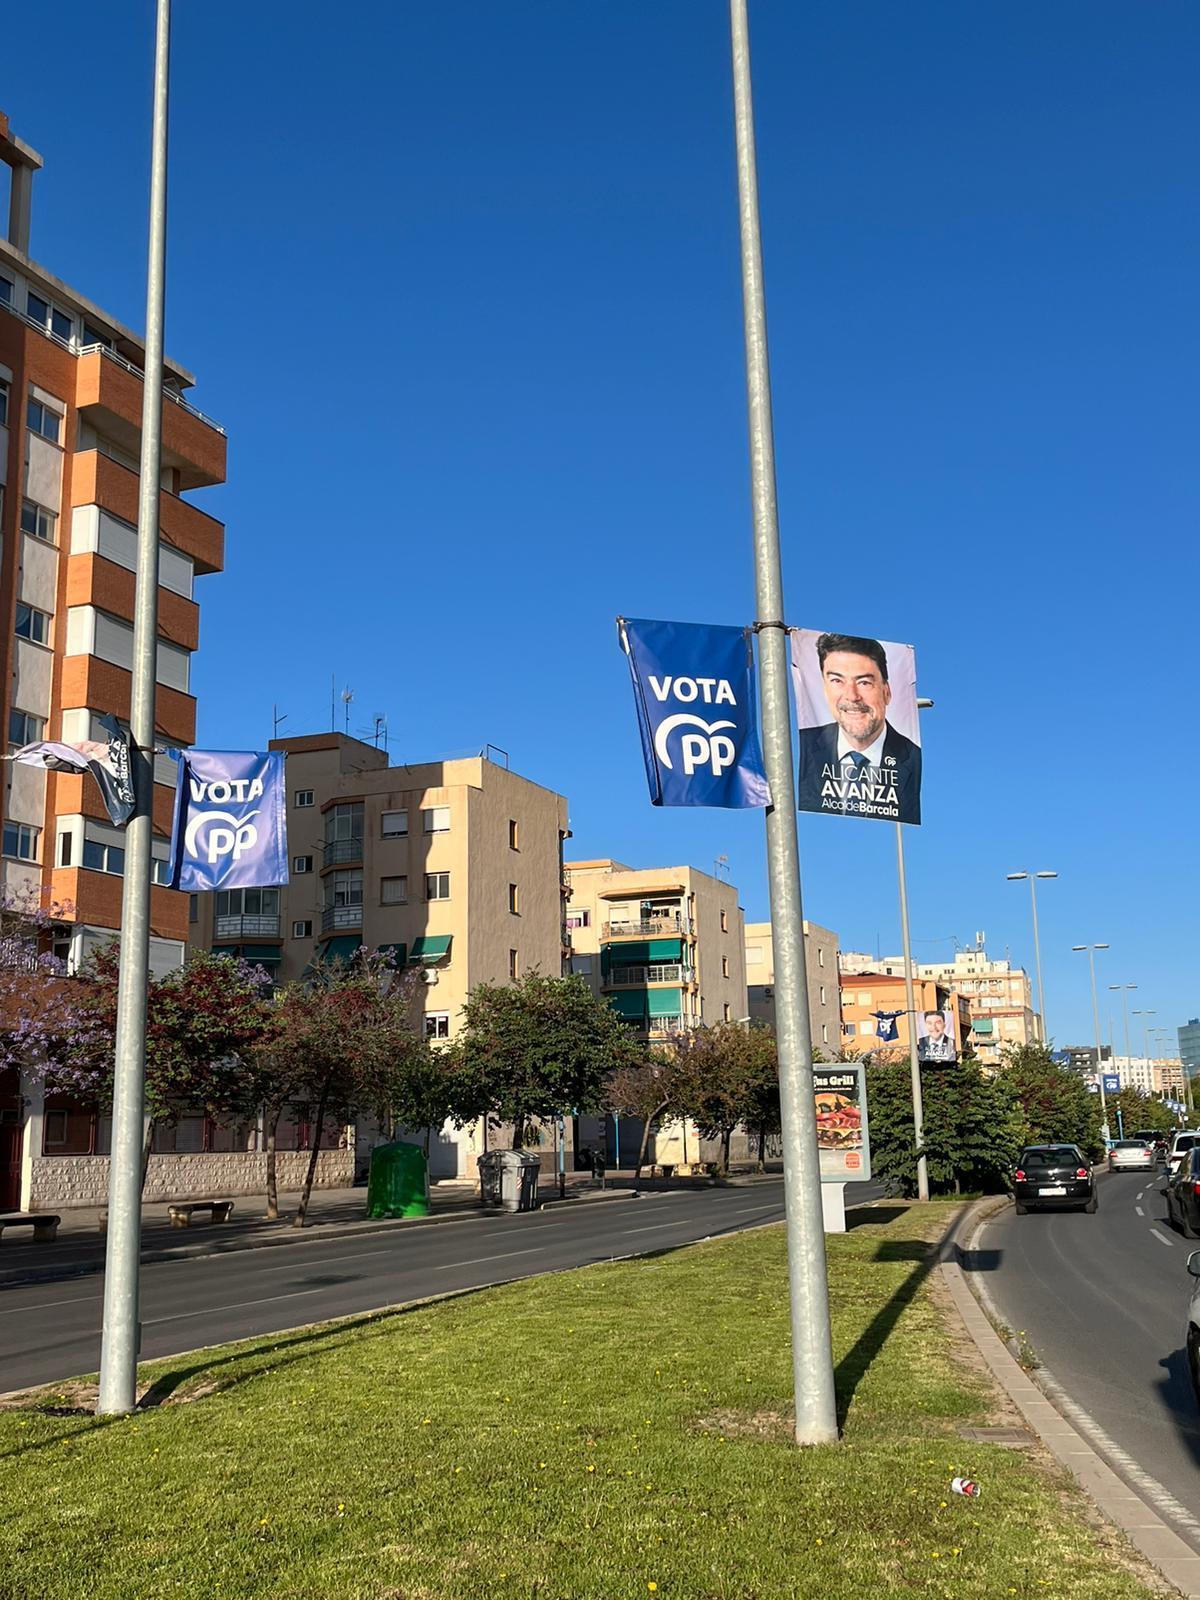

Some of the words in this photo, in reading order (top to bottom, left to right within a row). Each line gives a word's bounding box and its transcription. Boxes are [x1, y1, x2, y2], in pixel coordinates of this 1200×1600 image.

[648, 676, 737, 706] VOTA
[821, 763, 899, 786] ALICANTE
[189, 778, 264, 804] VOTA
[821, 780, 899, 804] AVANZA
[829, 1075, 855, 1086] Grill
